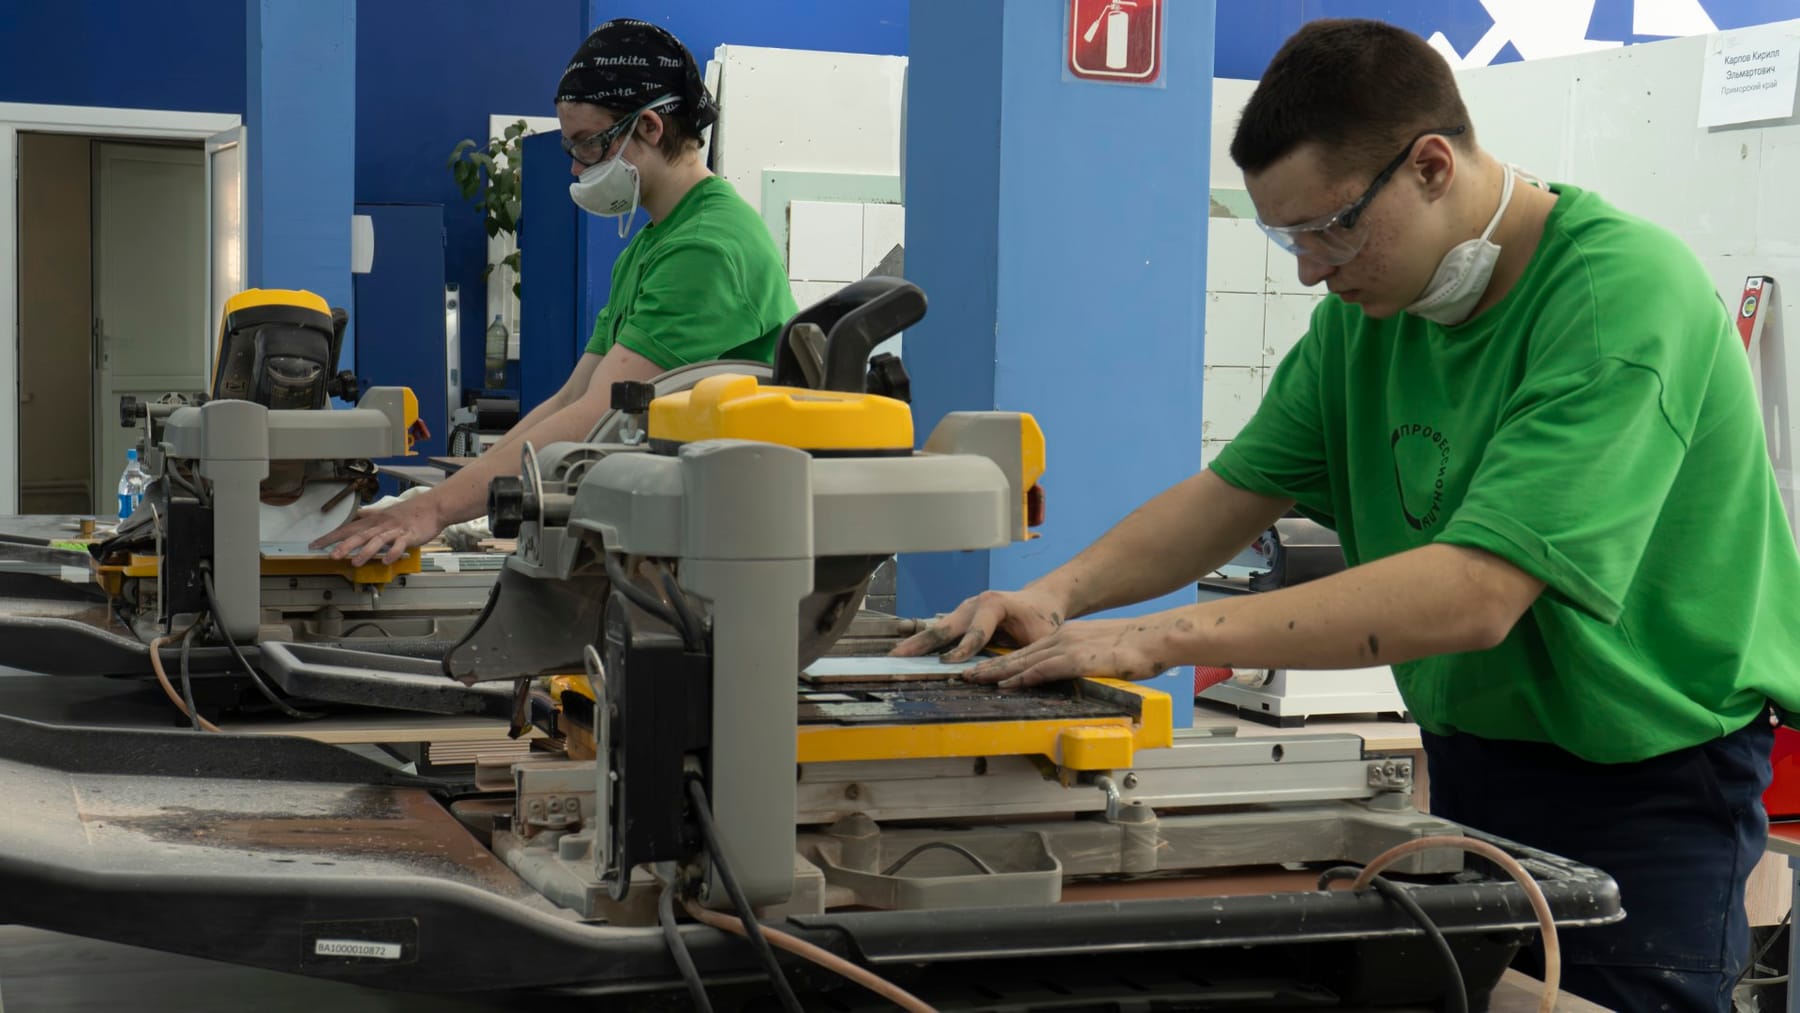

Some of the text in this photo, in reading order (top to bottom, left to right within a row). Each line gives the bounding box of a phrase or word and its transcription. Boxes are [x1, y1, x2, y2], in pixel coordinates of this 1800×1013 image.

[594, 55, 649, 66] makita
[1724, 49, 1780, 65] Карпов Кирилл
[1726, 66, 1776, 80] Эльмартович
[1721, 80, 1778, 96] Приморский край
